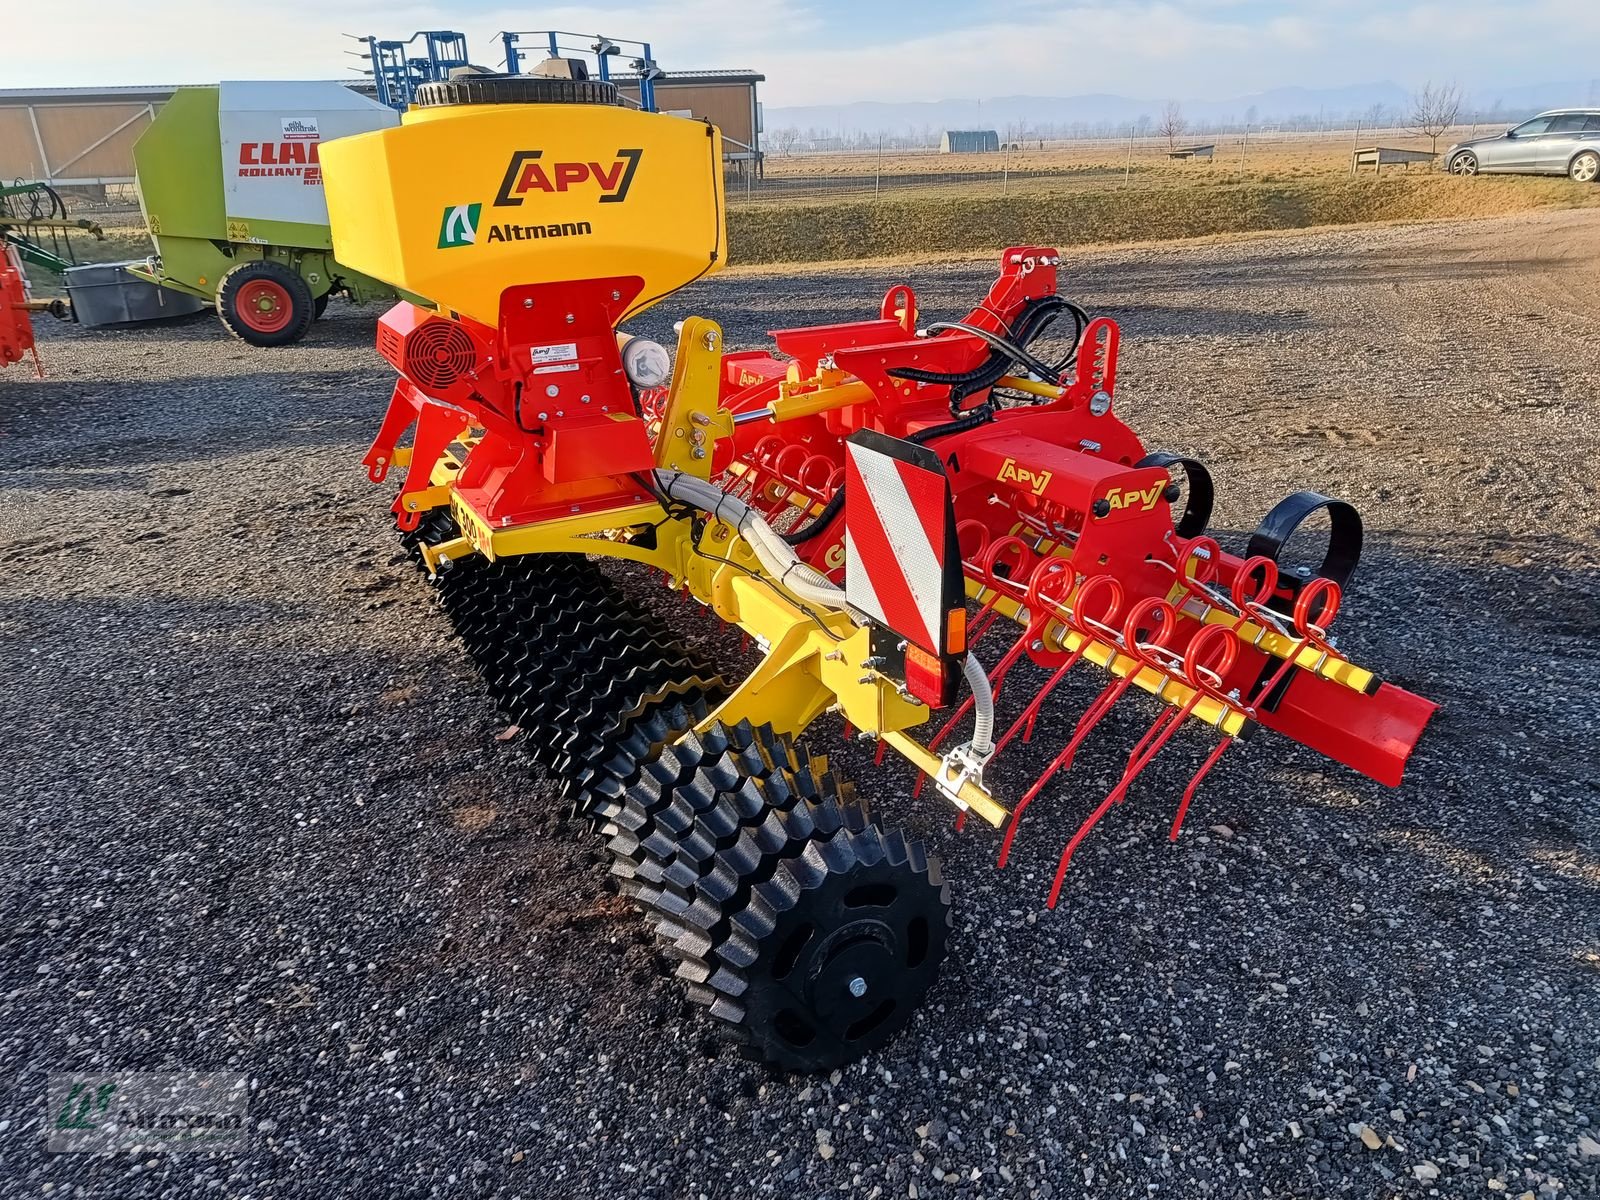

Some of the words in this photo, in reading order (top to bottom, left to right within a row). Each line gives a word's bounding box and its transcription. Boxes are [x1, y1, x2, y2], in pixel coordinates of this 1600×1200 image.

[238, 167, 303, 177] ROLLANT
[303, 167, 323, 179] 2
[487, 221, 592, 244] Altmann
